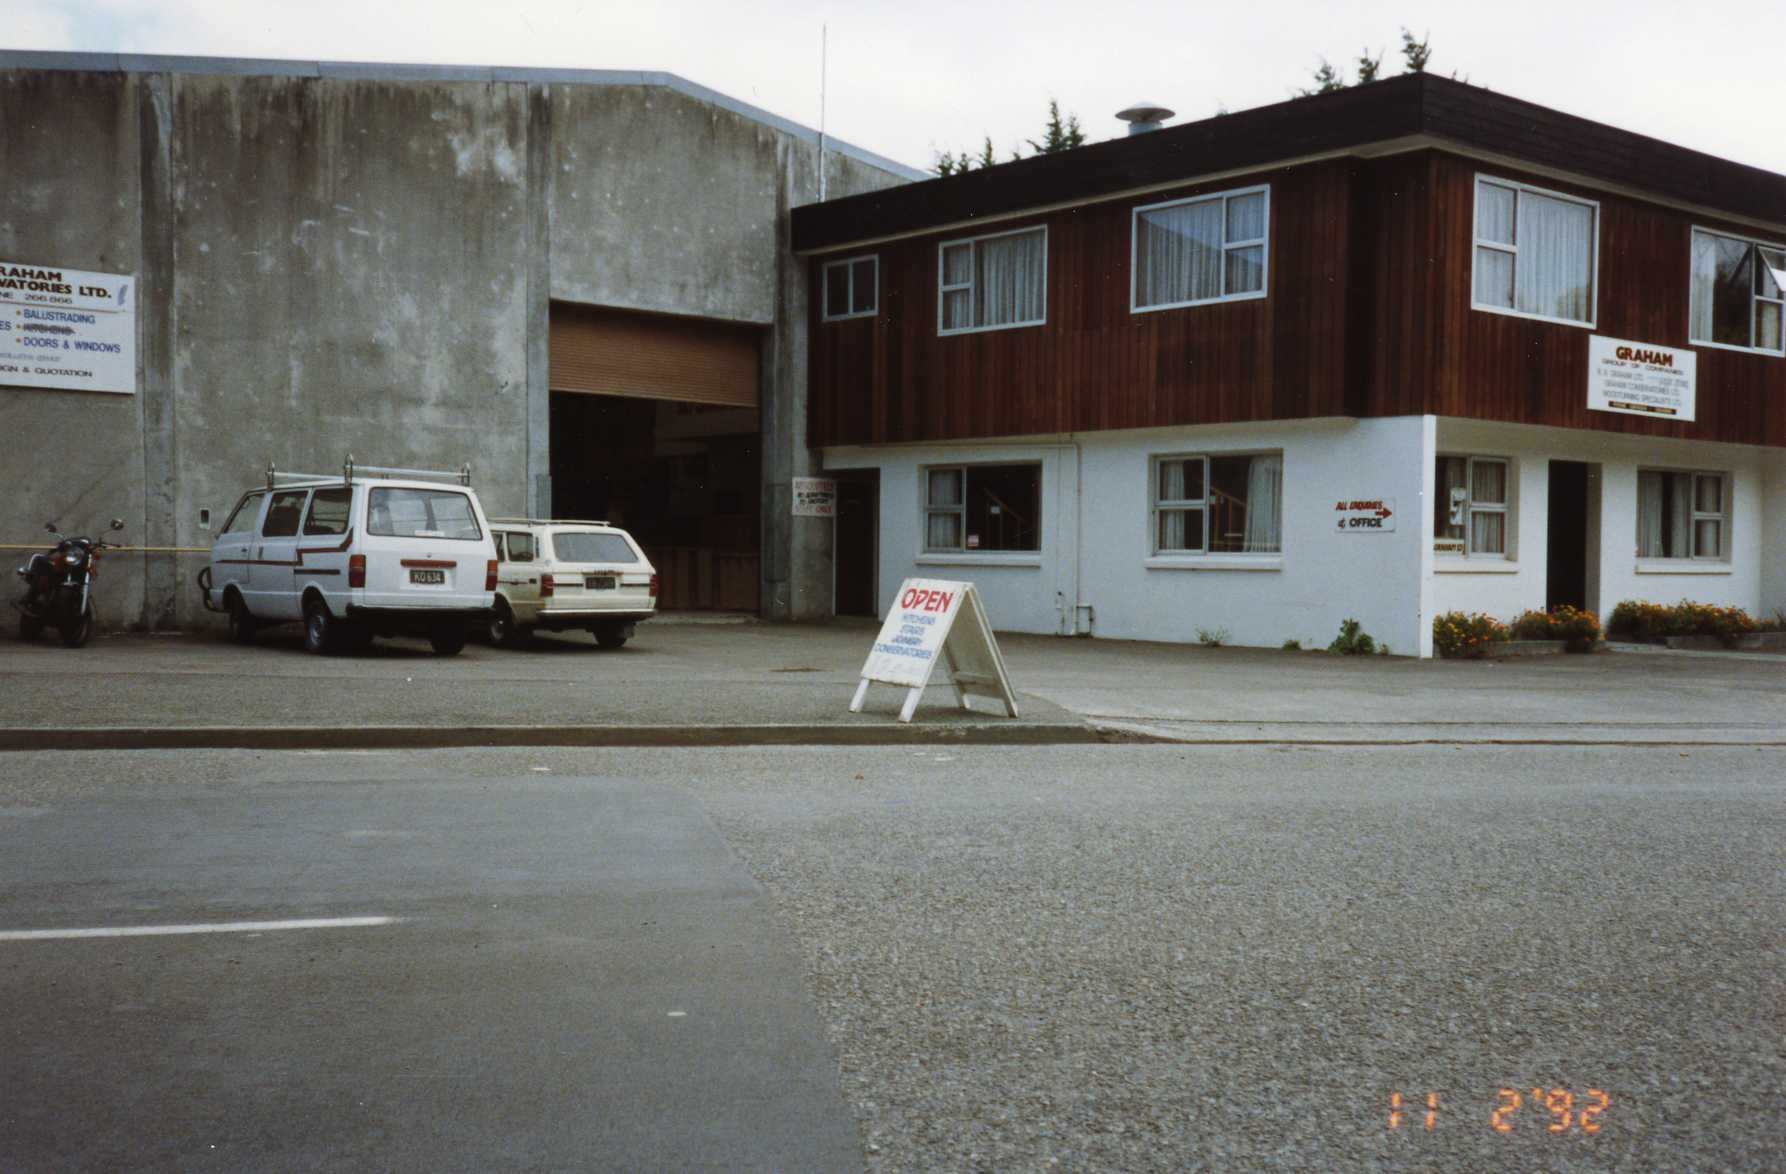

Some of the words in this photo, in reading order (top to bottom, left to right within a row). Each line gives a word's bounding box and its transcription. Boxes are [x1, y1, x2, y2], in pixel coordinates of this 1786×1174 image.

[79, 286, 112, 299] LTD.
[23, 308, 96, 324] BALUSTRADING
[23, 337, 59, 349] DOORS
[63, 340, 70, 350] &
[74, 341, 121, 353] WINDOWS
[1616, 346, 1673, 367] GRAHAM
[34, 367, 93, 378] QUOTATION
[1349, 518, 1383, 527] OFFICE
[901, 588, 954, 613] OPEN
